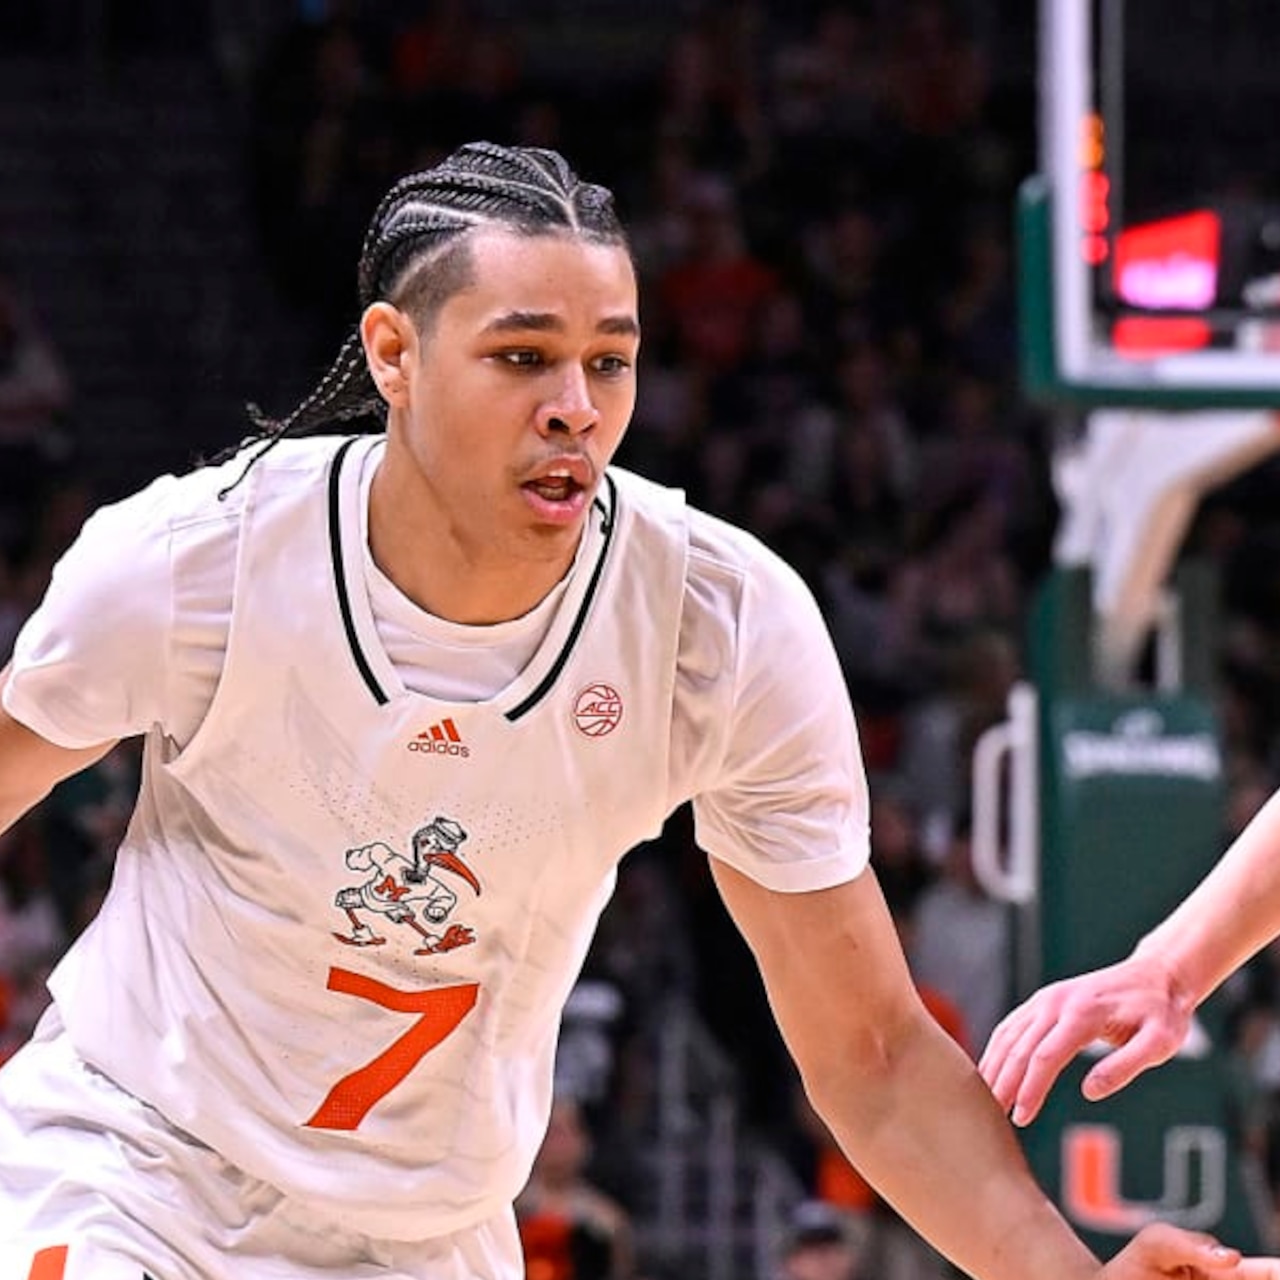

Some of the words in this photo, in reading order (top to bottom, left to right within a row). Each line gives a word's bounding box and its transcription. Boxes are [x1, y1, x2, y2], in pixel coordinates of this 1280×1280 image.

[581, 701, 620, 714] ACC
[407, 739, 470, 757] adidas
[300, 966, 479, 1131] 7
[1061, 1124, 1227, 1234] U
